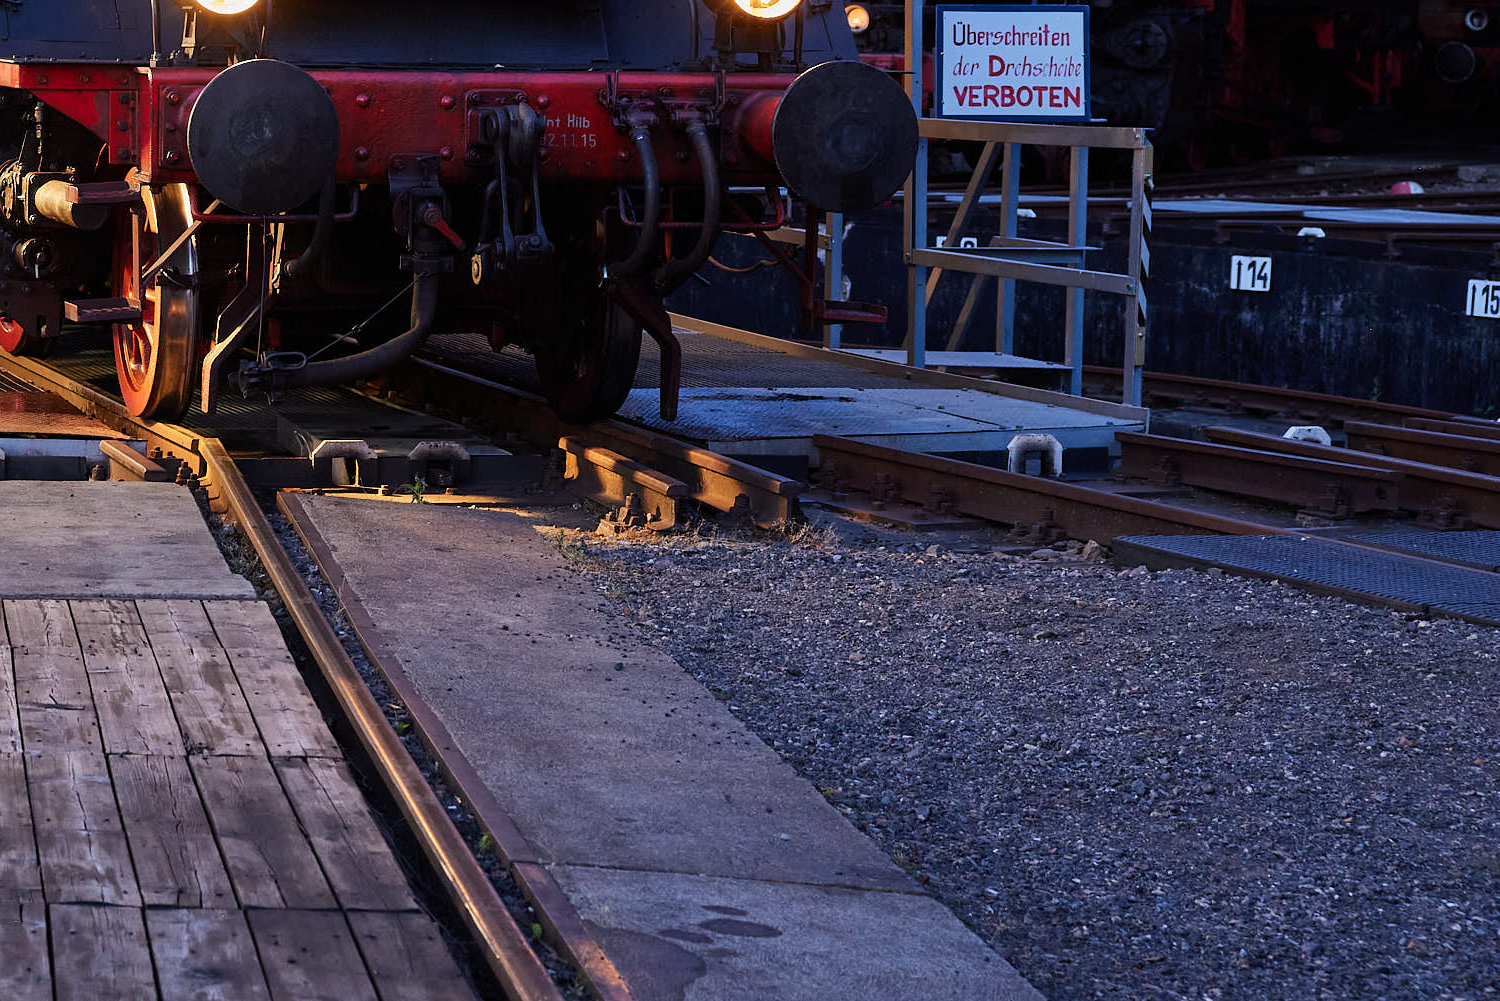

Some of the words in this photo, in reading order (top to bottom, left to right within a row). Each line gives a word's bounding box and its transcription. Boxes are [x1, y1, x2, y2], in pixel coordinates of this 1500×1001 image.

[952, 21, 1070, 47] Überschreiten
[952, 55, 980, 77] der
[988, 54, 1082, 77] Drehscheibe
[952, 84, 1081, 108] VERBOTEN
[1247, 260, 1268, 289] 14
[1481, 284, 1500, 315] 15
